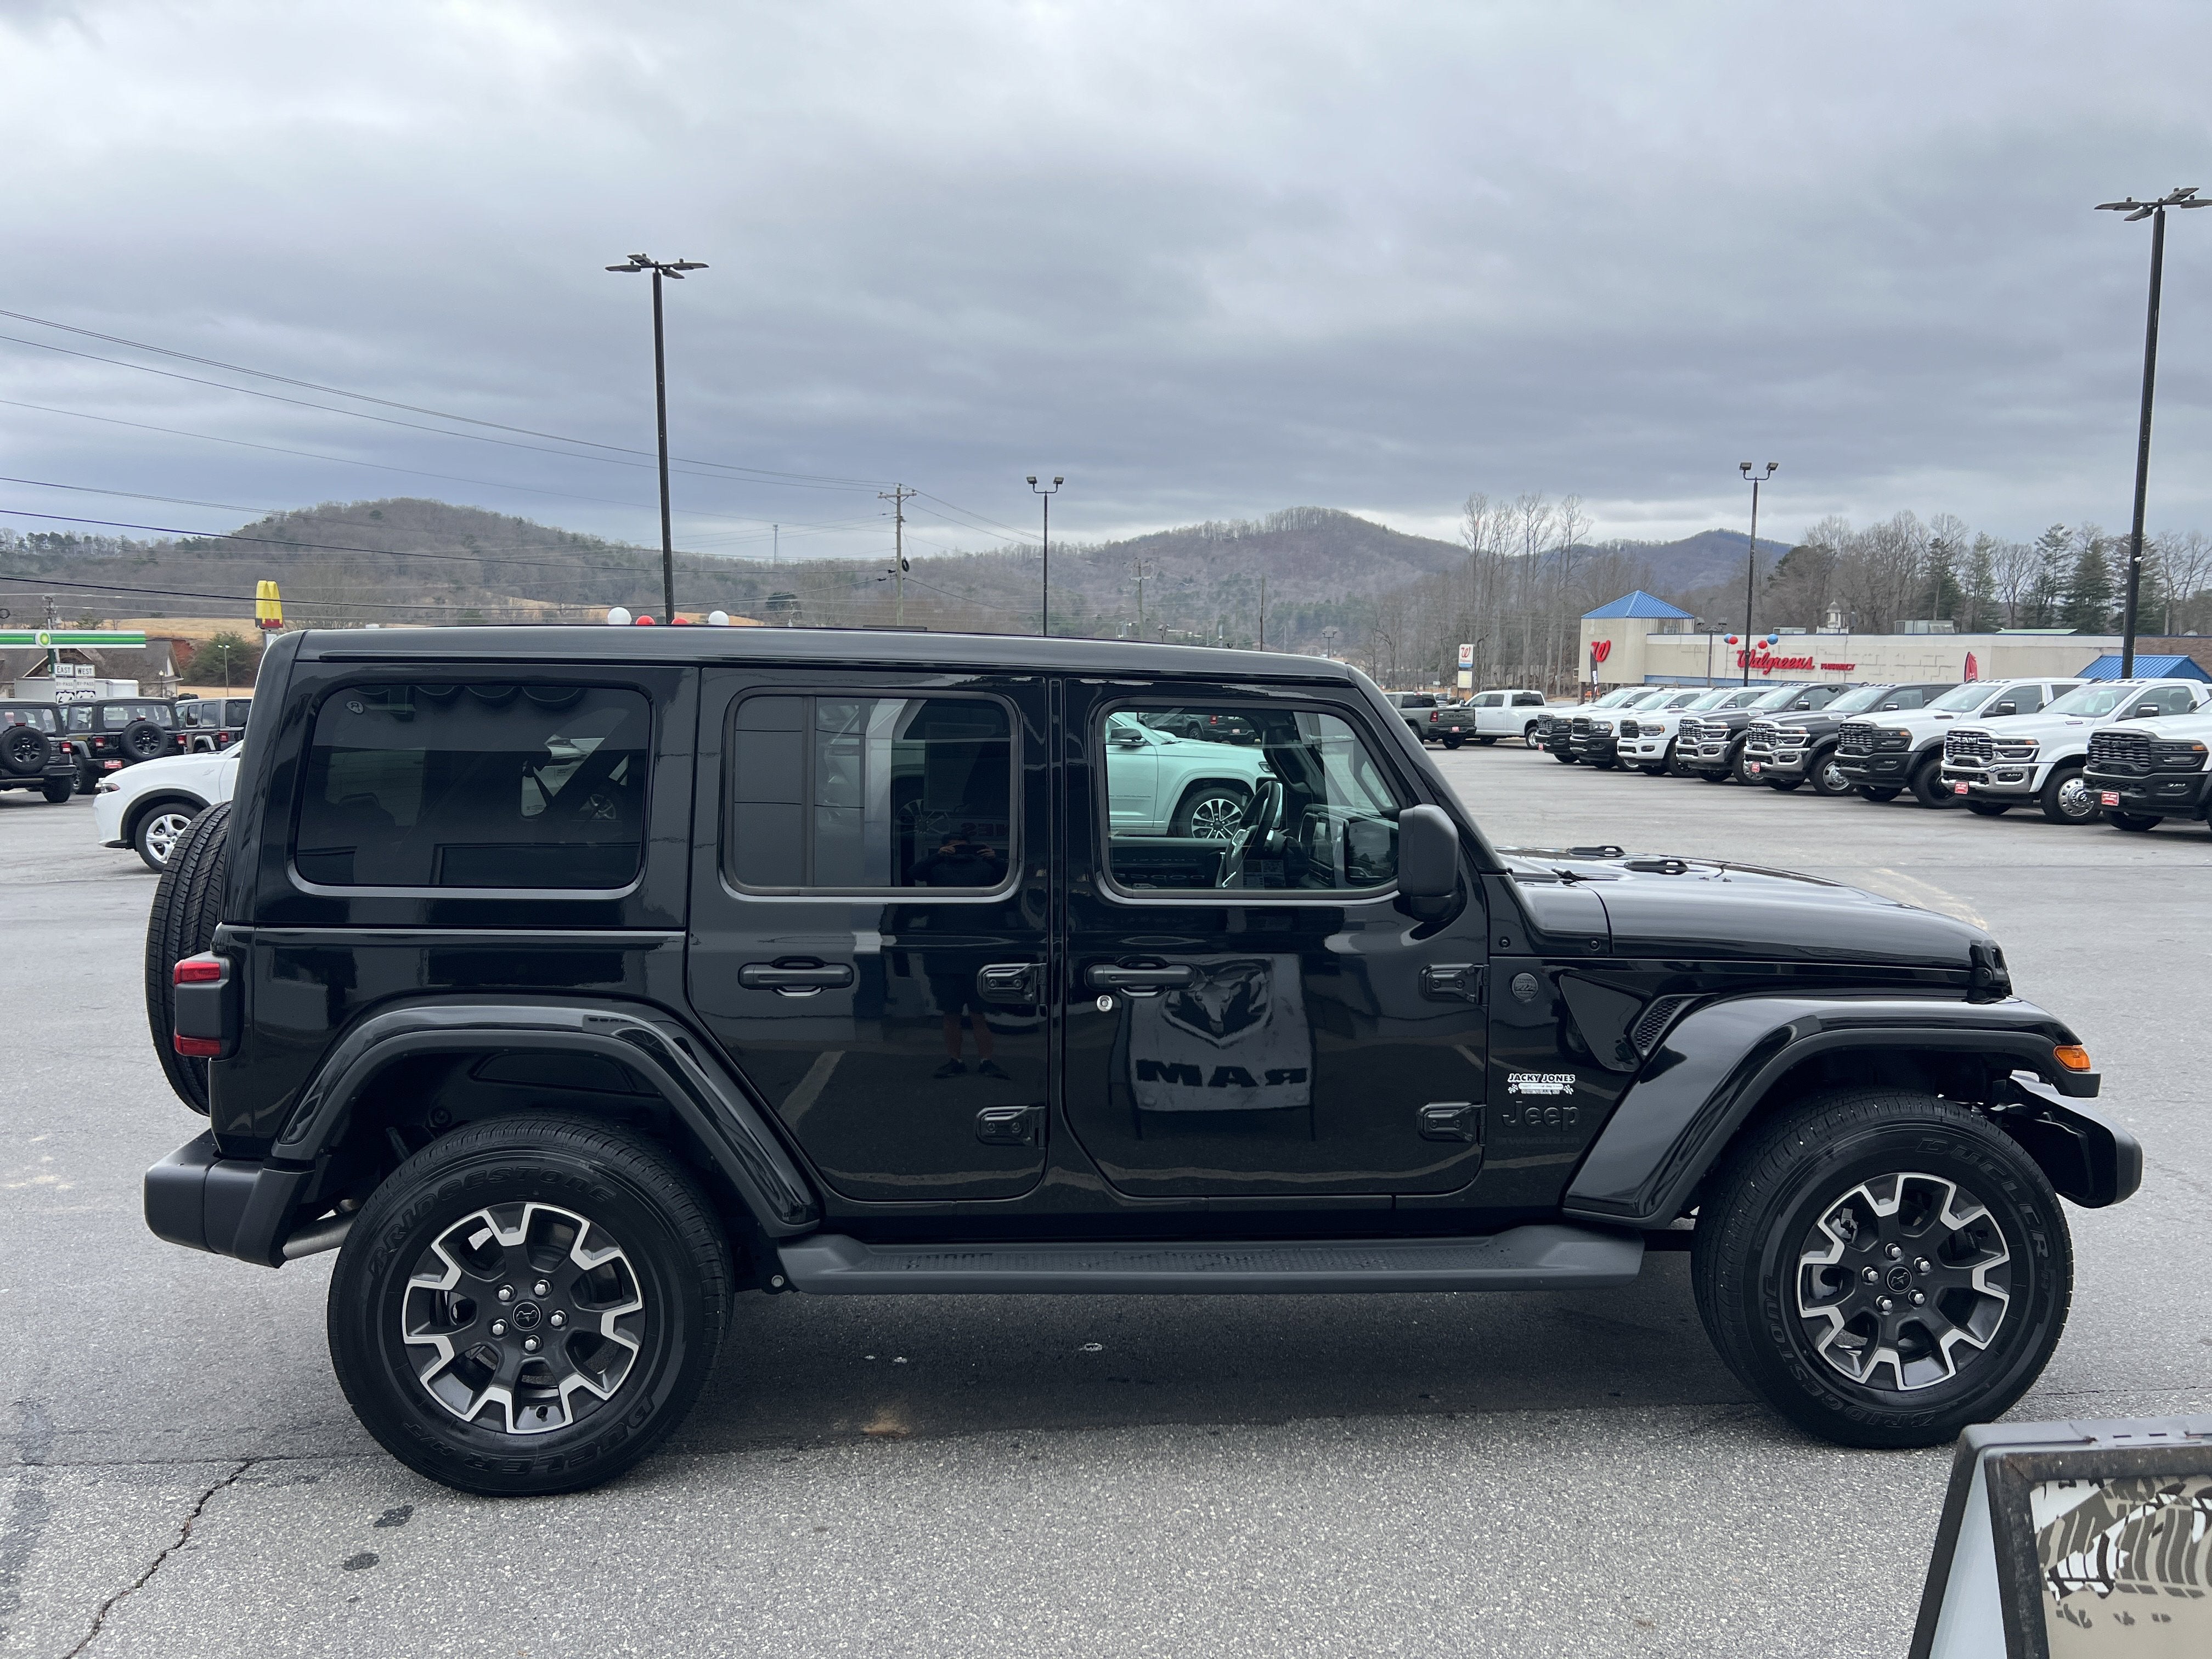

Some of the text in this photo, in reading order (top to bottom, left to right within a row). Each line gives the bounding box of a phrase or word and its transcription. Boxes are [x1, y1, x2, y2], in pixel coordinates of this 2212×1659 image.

[57, 665, 71, 674] EAST
[1736, 649, 1815, 675] Walgreens
[1508, 1074, 1576, 1082] JACKY JONES
[1502, 1100, 1580, 1131] Jeep
[370, 1166, 615, 1275] BRIDGESTONE
[465, 1394, 655, 1474] DUELER
